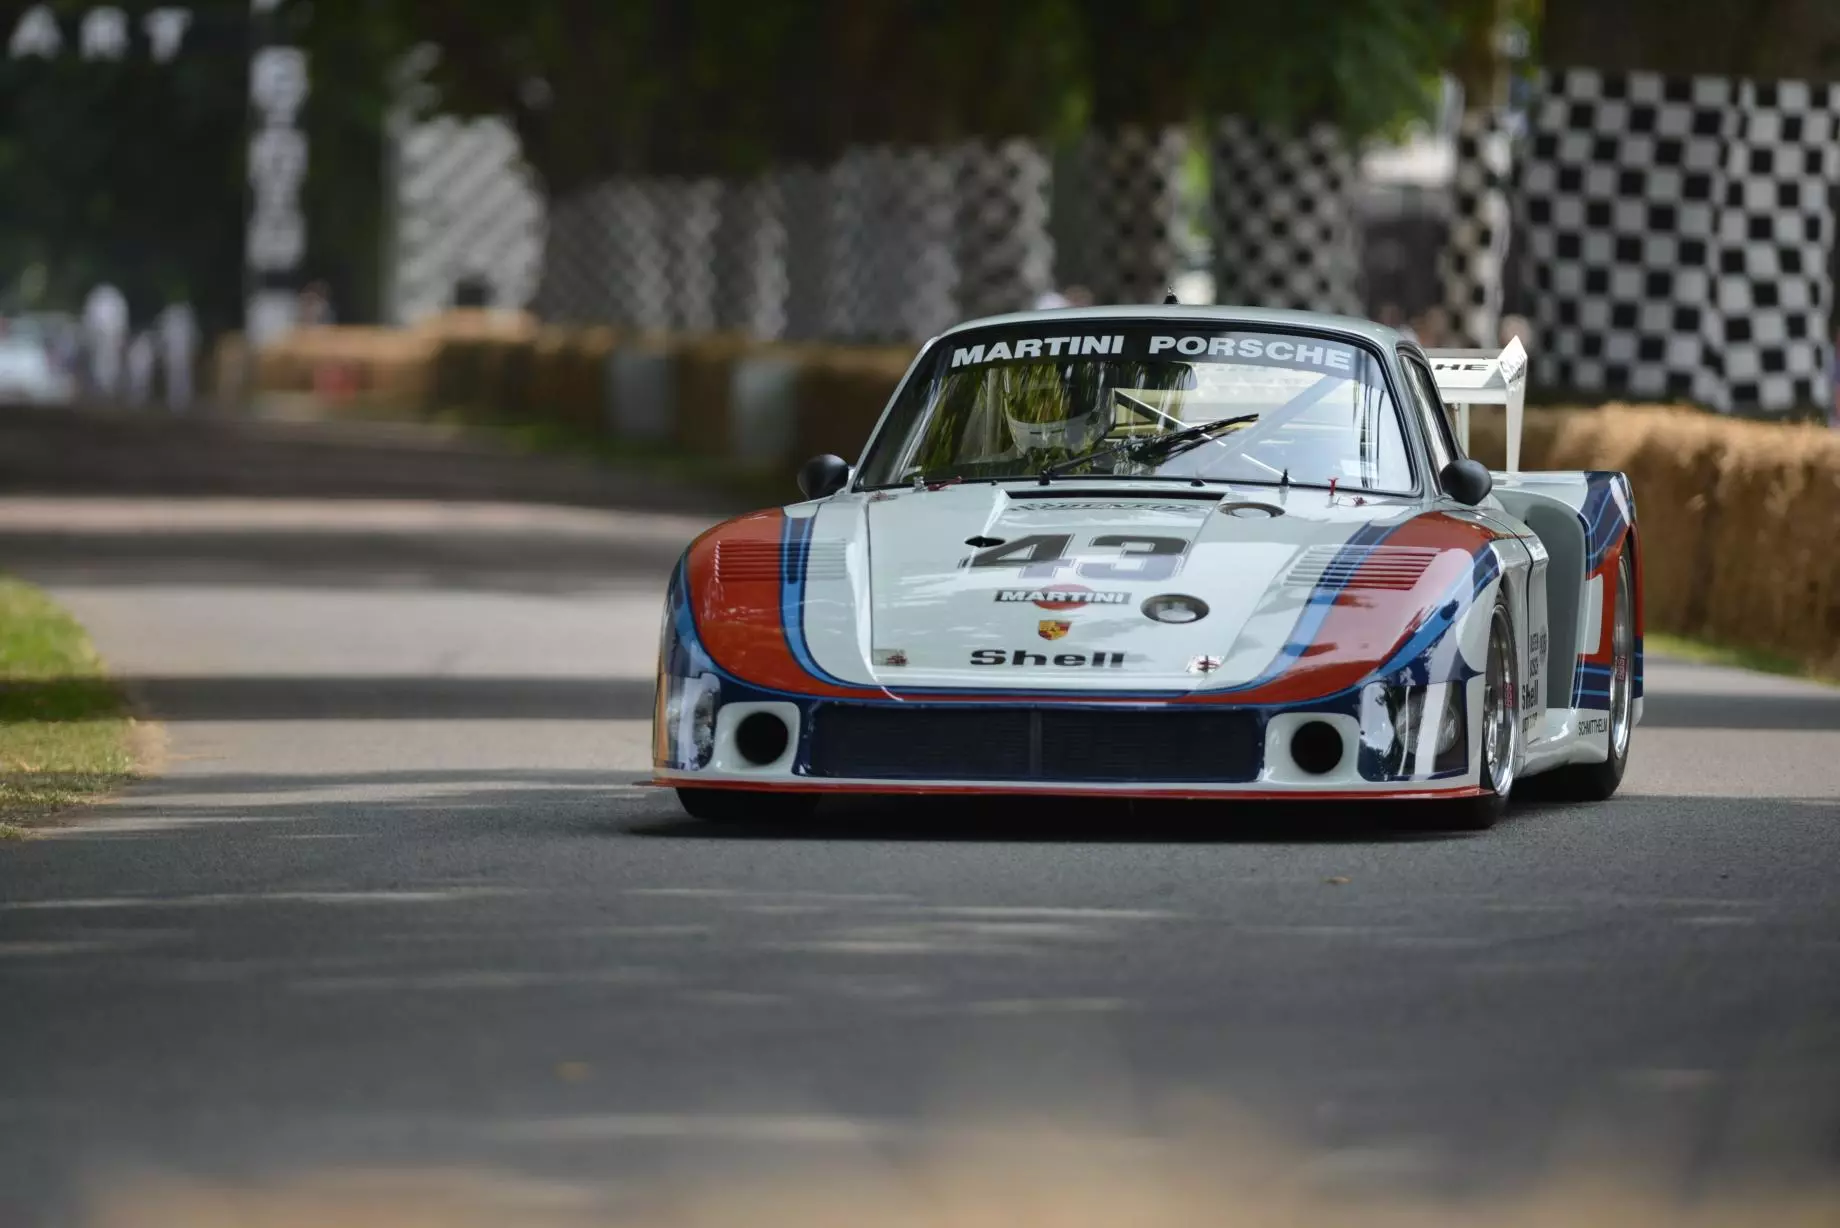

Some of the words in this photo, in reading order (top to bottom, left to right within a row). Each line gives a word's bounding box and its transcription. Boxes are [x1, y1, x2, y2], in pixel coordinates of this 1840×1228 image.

[951, 335, 1125, 368] MARTINI
[1149, 336, 1354, 371] PORSCHE
[958, 534, 1190, 581] 43
[1001, 591, 1125, 604] MARTINI
[970, 649, 1125, 668] Shell
[1521, 680, 1539, 710] Shell
